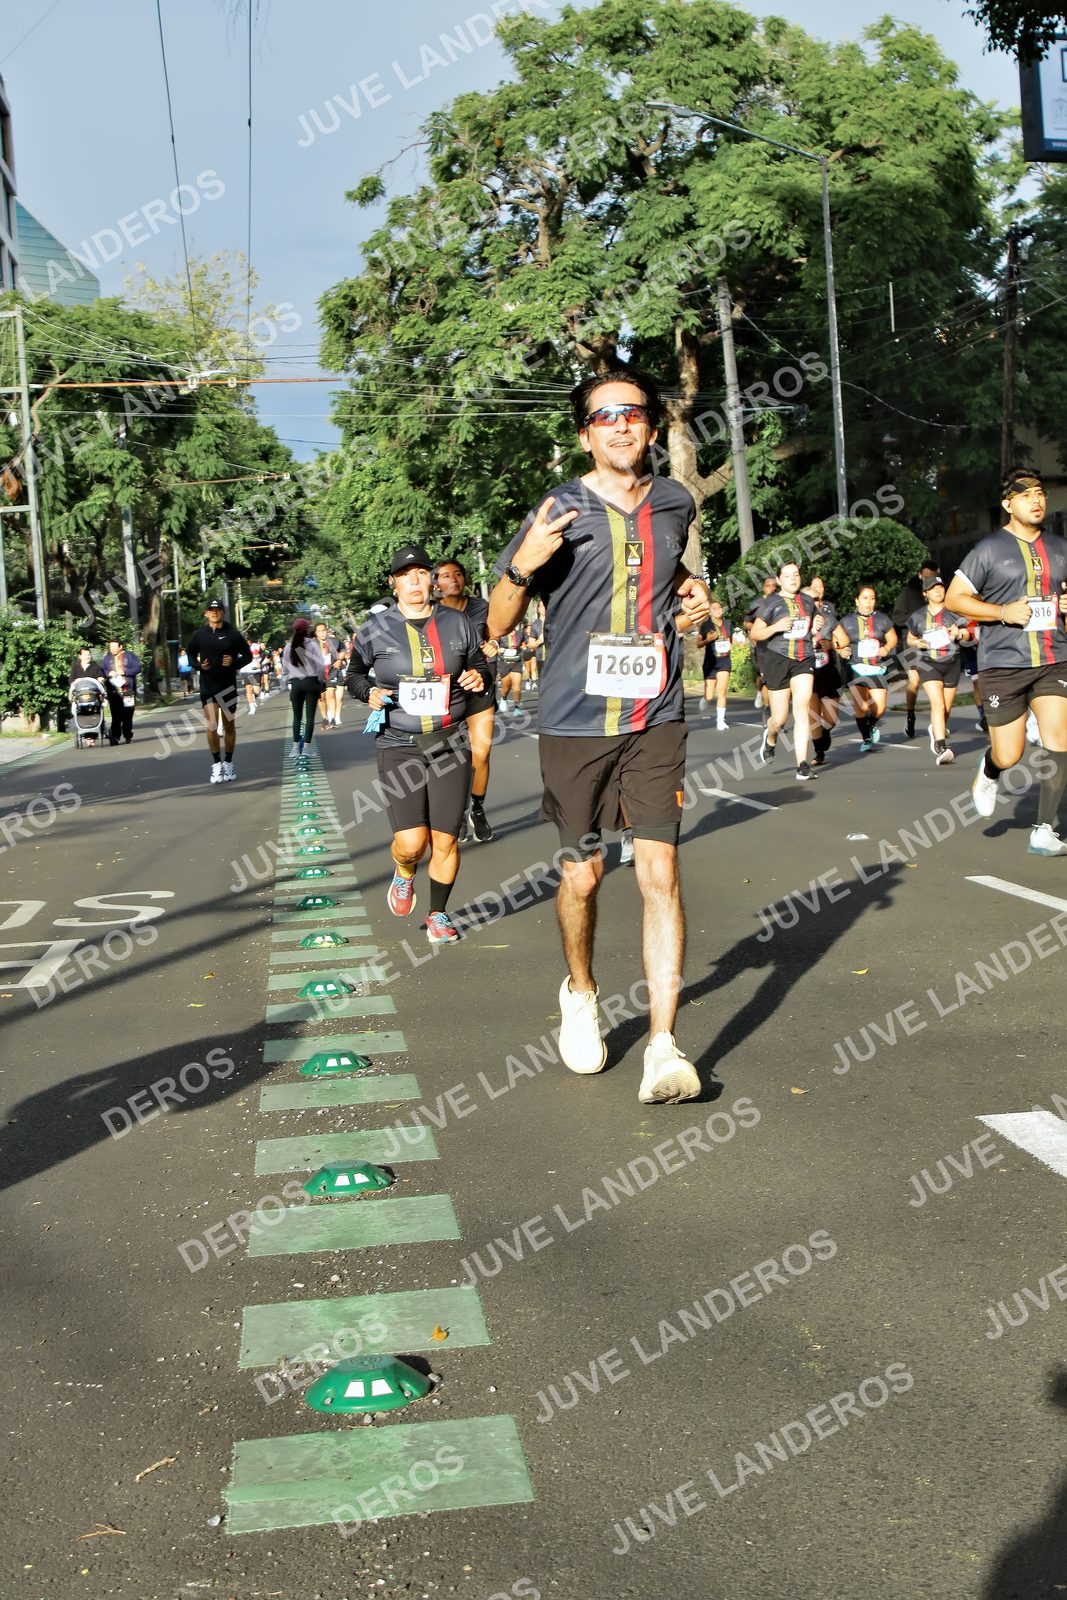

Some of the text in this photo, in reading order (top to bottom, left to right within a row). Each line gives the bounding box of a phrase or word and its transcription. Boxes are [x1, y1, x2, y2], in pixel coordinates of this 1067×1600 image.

[1034, 606, 1052, 618] 816
[594, 654, 657, 676] 12669
[411, 687, 433, 701] 541
